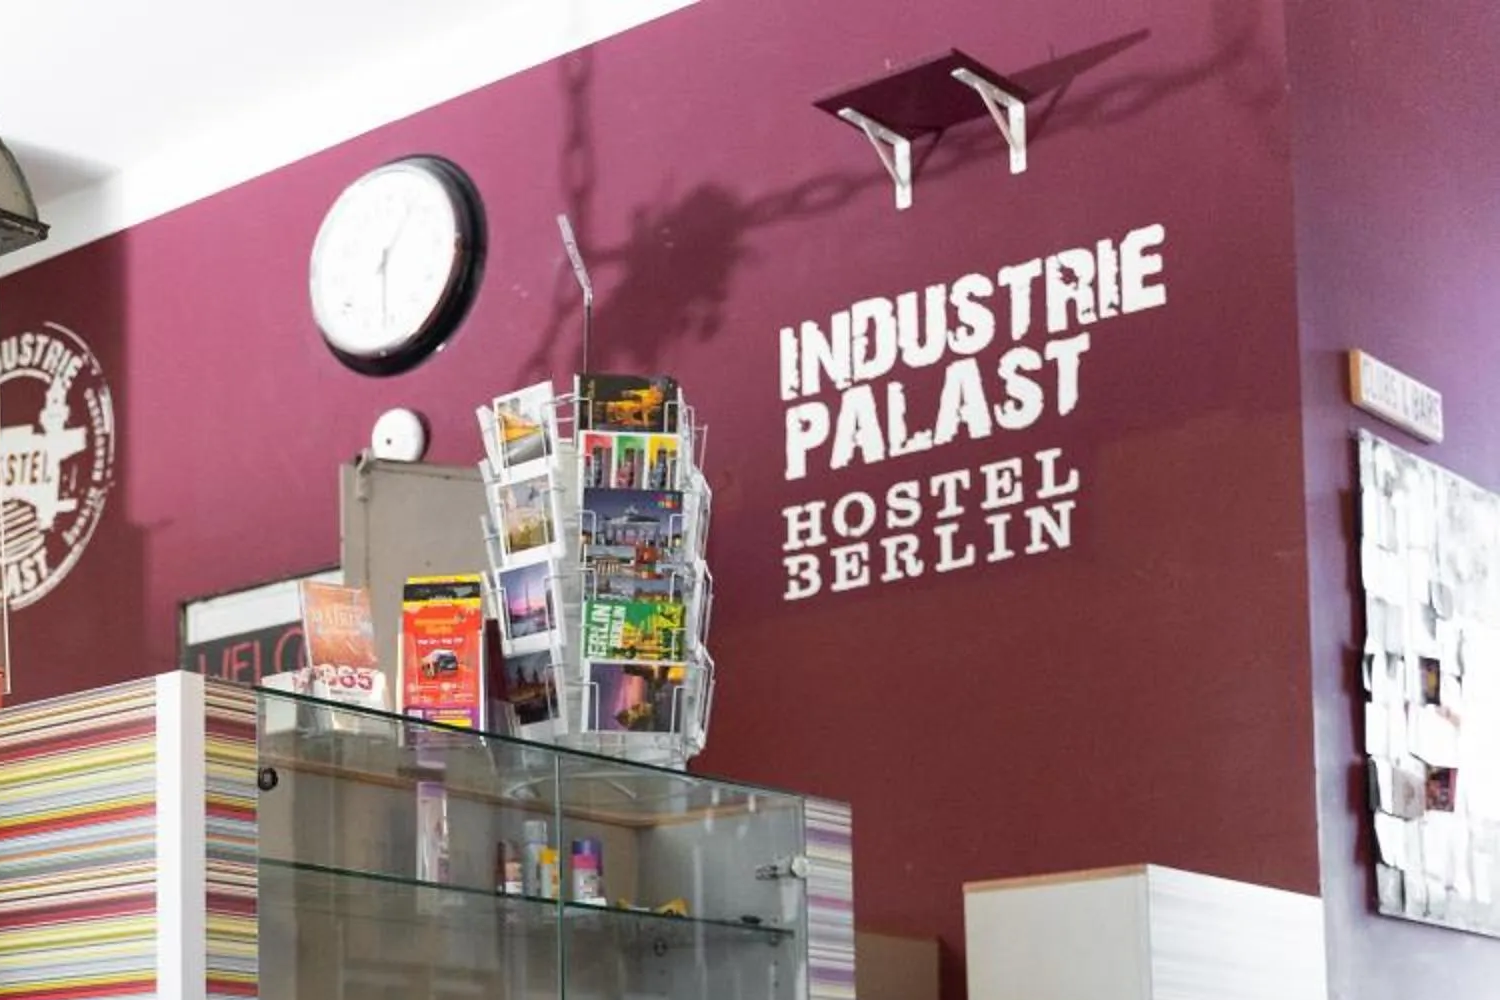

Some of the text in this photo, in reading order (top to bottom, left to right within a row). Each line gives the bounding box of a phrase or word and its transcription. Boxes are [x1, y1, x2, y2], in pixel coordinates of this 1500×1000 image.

[779, 223, 1167, 400] INDUSTRIE
[784, 333, 1091, 480] PALAST
[781, 447, 1080, 551] HOSTEL
[782, 500, 1076, 600] BERLIN
